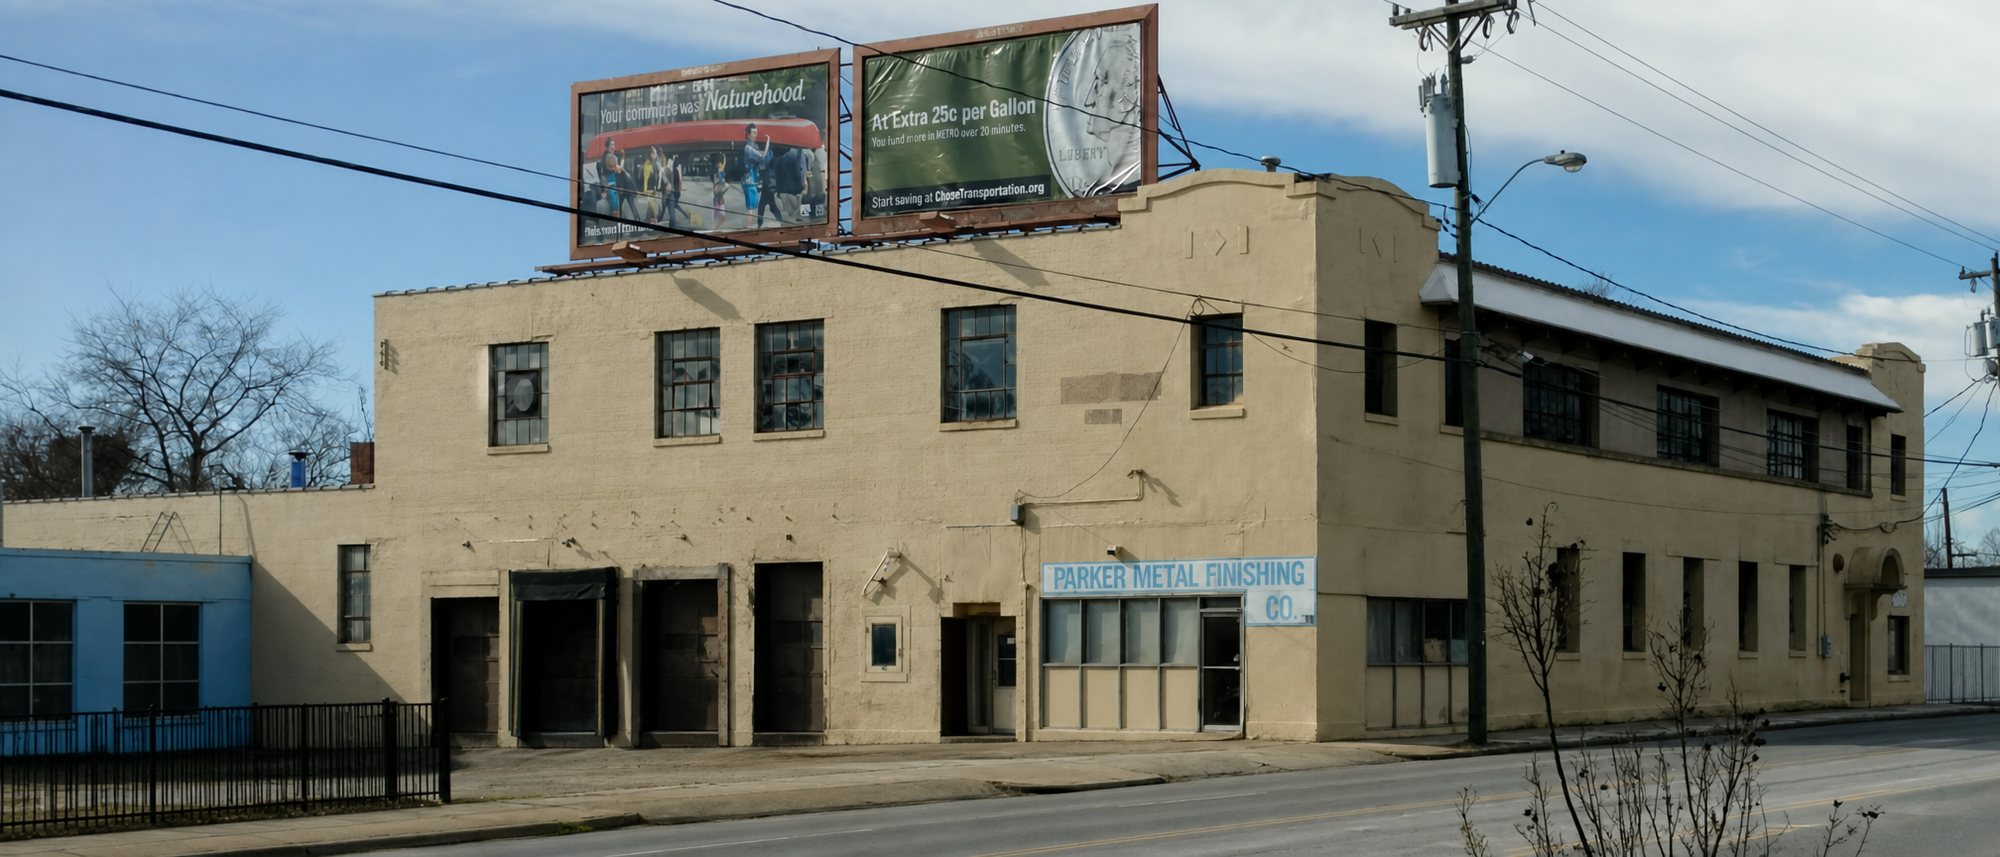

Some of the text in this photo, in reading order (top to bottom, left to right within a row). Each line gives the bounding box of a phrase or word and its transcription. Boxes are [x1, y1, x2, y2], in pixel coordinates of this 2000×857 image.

[600, 108, 624, 124] Your
[680, 100, 701, 115] was
[704, 79, 806, 112] Naturehood.
[872, 97, 1036, 132] At Extra 25c per Gallon
[872, 136, 886, 148] You
[906, 132, 927, 144] more
[927, 130, 936, 141] in
[960, 128, 979, 138] over
[980, 126, 990, 137] 20
[991, 123, 1026, 136] minutes.
[872, 183, 1045, 209] Start saving at ChoseTransportation.org
[1053, 560, 1305, 590] PARKER METAL FINISHING
[1265, 594, 1298, 621] CO.
